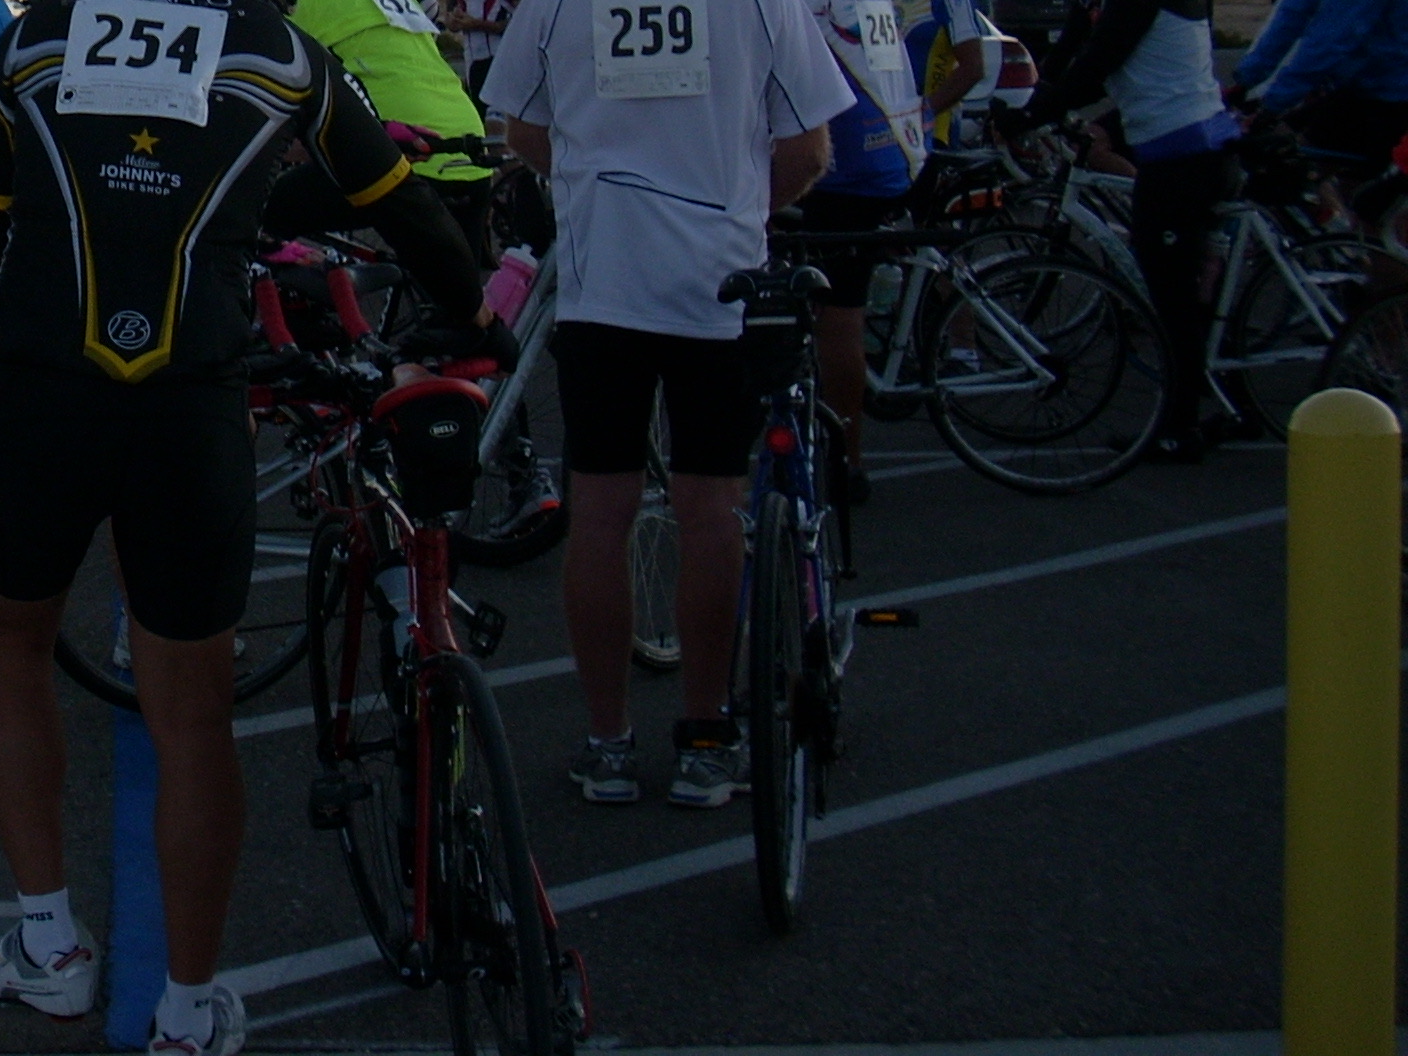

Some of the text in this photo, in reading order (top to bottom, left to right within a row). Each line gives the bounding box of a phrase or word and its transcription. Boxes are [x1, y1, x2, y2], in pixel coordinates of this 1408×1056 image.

[84, 14, 201, 75] 254
[610, 5, 693, 57] 259
[865, 13, 896, 45] 245
[99, 163, 181, 189] JOHNNY'S
[107, 178, 171, 196] BIKE SHOP
